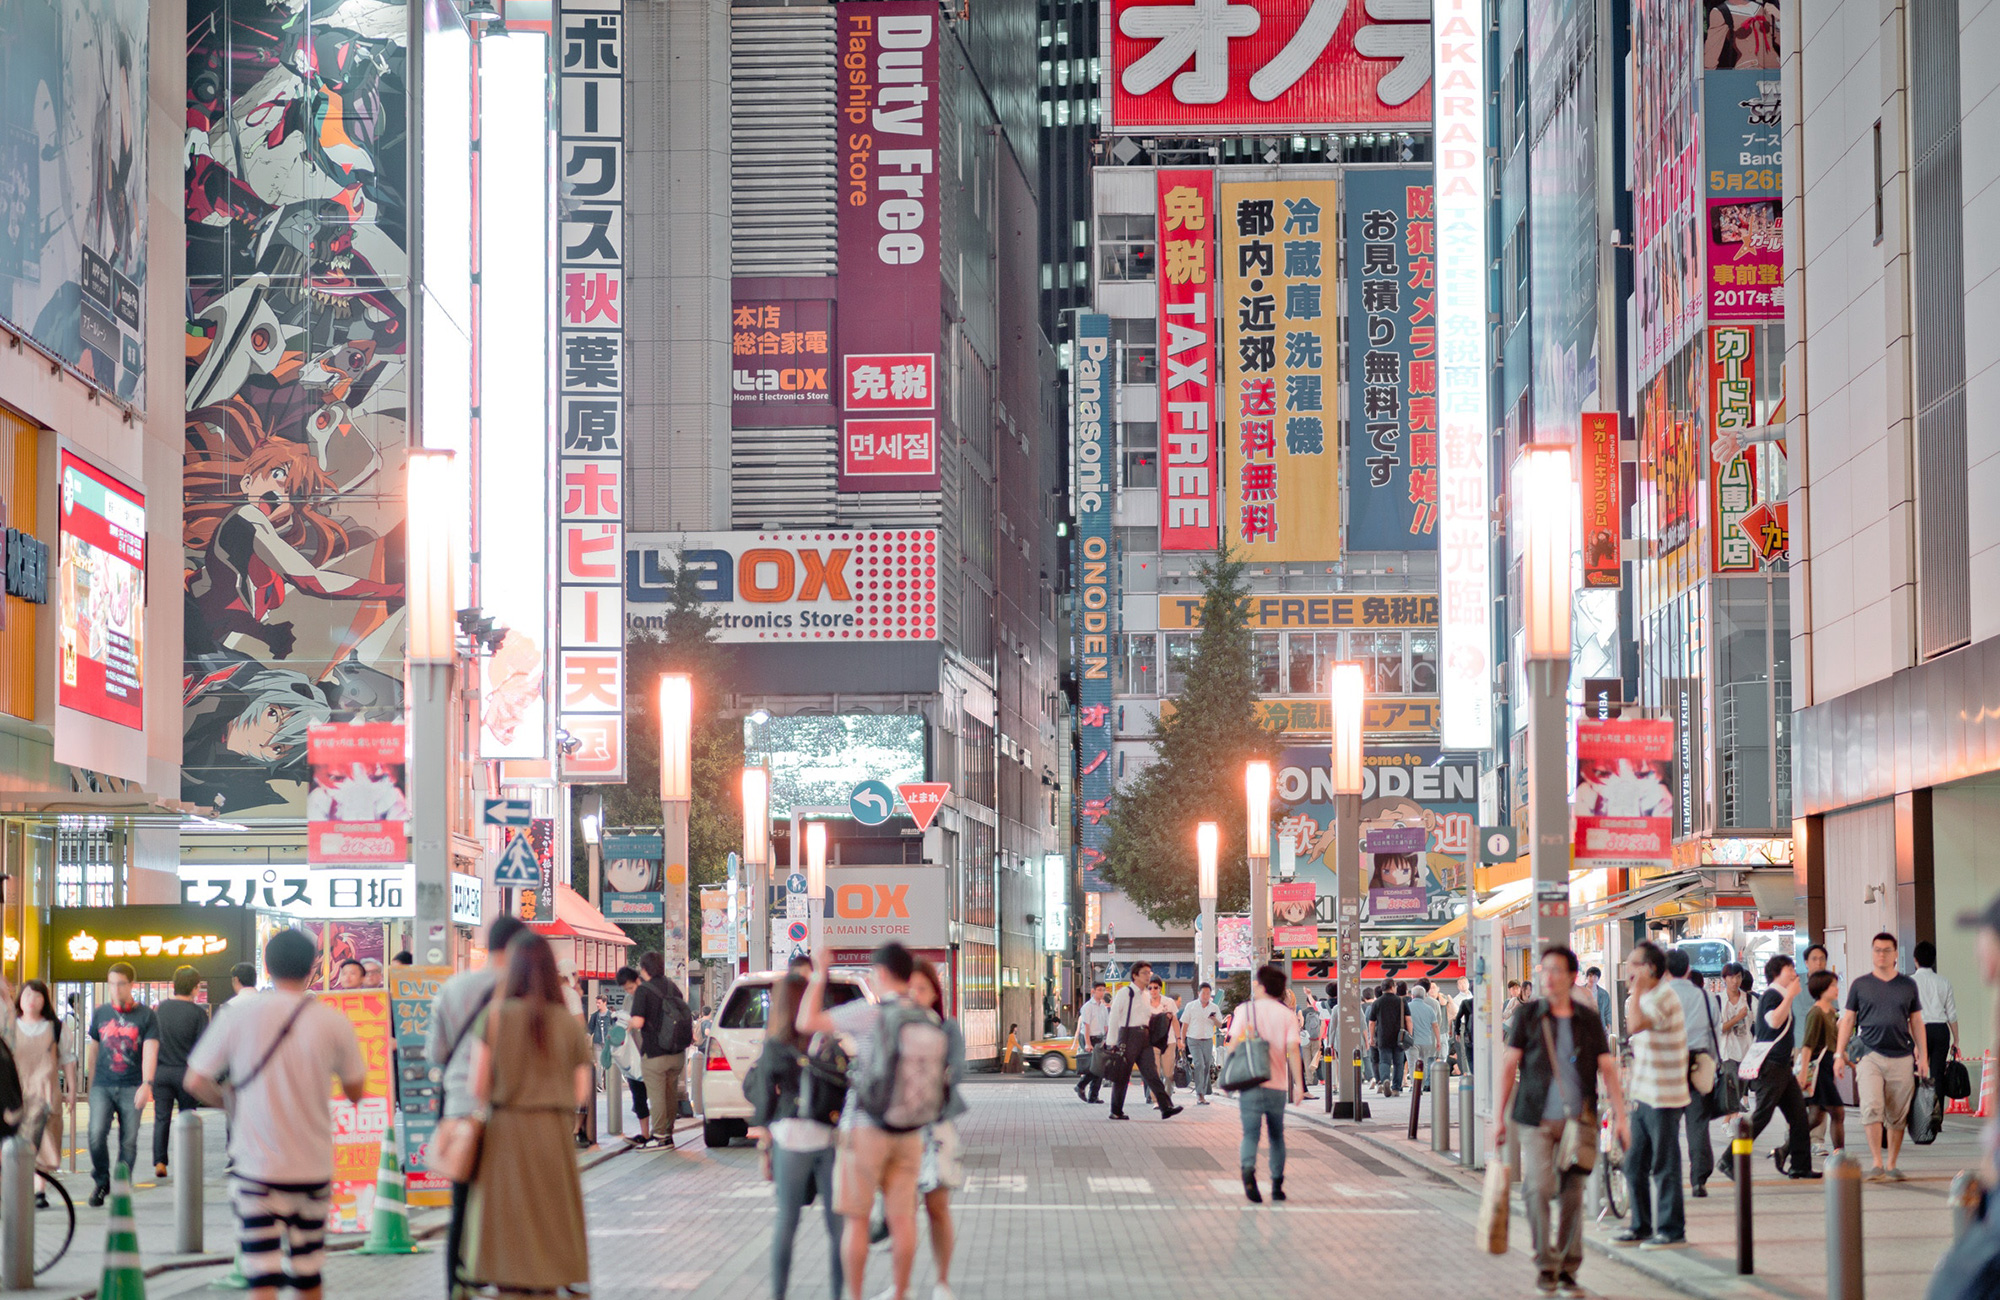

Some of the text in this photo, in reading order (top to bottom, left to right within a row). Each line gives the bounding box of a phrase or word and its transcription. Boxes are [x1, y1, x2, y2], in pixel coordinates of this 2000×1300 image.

[845, 15, 872, 206] Flagship Store
[872, 15, 933, 265] Duty Free
[1713, 264, 1784, 286] 事前登
[733, 306, 780, 329] 本店
[733, 331, 828, 356] 総合家電
[1362, 210, 1400, 487] お見積り無料です
[1164, 186, 1209, 529] 免税 TAX FREE
[565, 17, 618, 772] ボークス秋葉原ホビー天国
[852, 364, 927, 400] 免税
[734, 393, 757, 401] Home
[806, 391, 829, 400] Store
[1080, 337, 1108, 513] Panasonic
[850, 433, 929, 460] 면세점
[1717, 331, 1751, 566] カードゲム専門店
[800, 609, 853, 628] Store
[1083, 536, 1108, 679] ONODEN
[1260, 600, 1354, 626] FREE
[1404, 753, 1422, 766] to
[908, 790, 939, 804] 止まれ
[837, 925, 867, 935] MAIN
[870, 924, 911, 935] STORE
